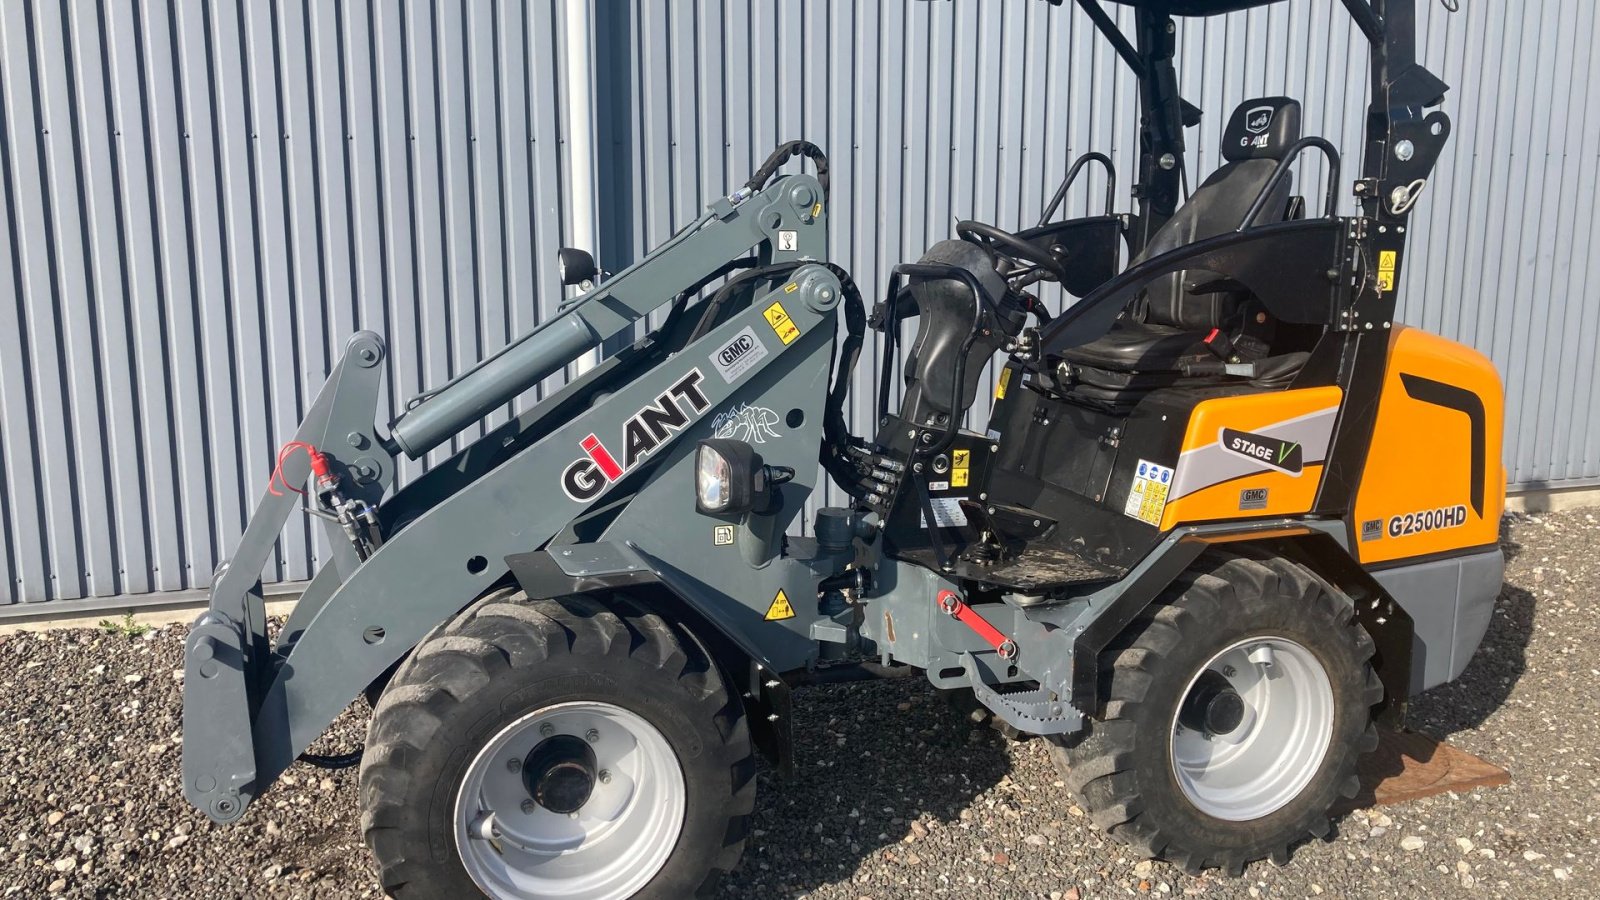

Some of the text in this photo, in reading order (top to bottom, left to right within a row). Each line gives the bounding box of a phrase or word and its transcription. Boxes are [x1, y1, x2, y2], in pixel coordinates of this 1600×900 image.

[721, 337, 750, 364] GMC
[1231, 437, 1299, 464] STAGE V
[1245, 489, 1264, 500] GMC
[1388, 505, 1467, 538] G2500HD
